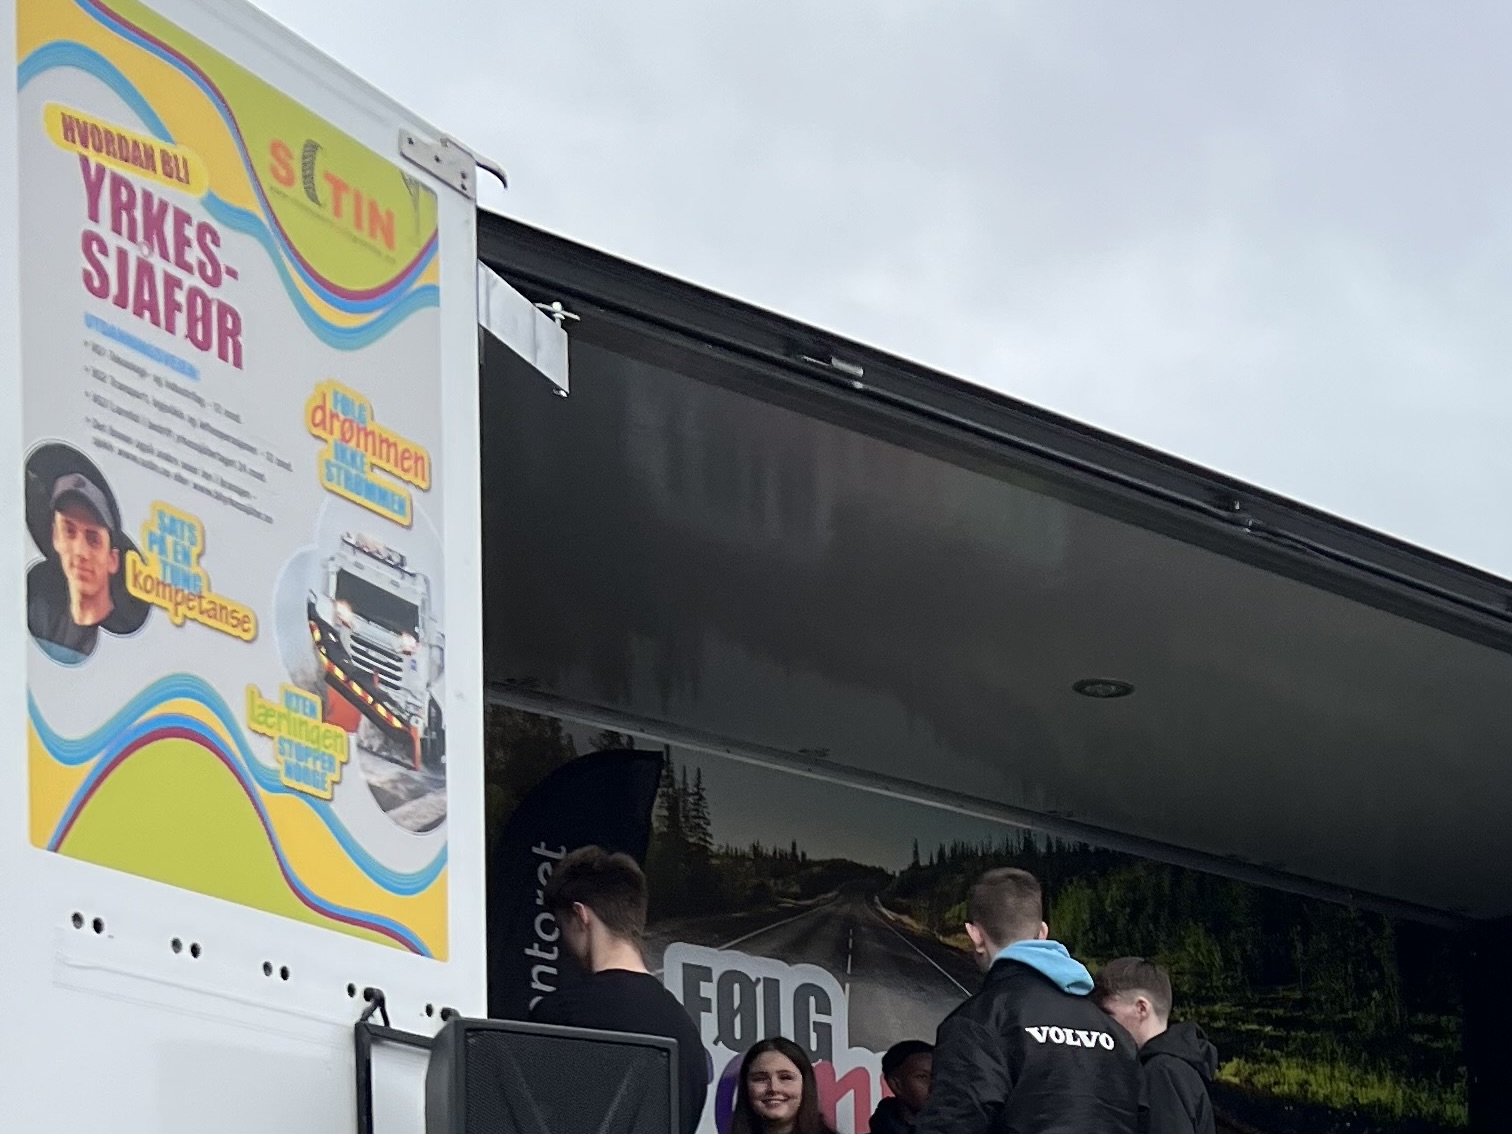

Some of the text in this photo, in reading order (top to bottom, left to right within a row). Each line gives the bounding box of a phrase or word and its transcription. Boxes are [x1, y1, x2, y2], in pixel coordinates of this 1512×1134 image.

[159, 148, 190, 185] BLI
[79, 152, 239, 289] YRKES-
[311, 391, 426, 482] drømmen
[132, 558, 252, 634] kompetanse
[682, 962, 834, 1064] FØLG
[1024, 1025, 1116, 1051] VOLVO
